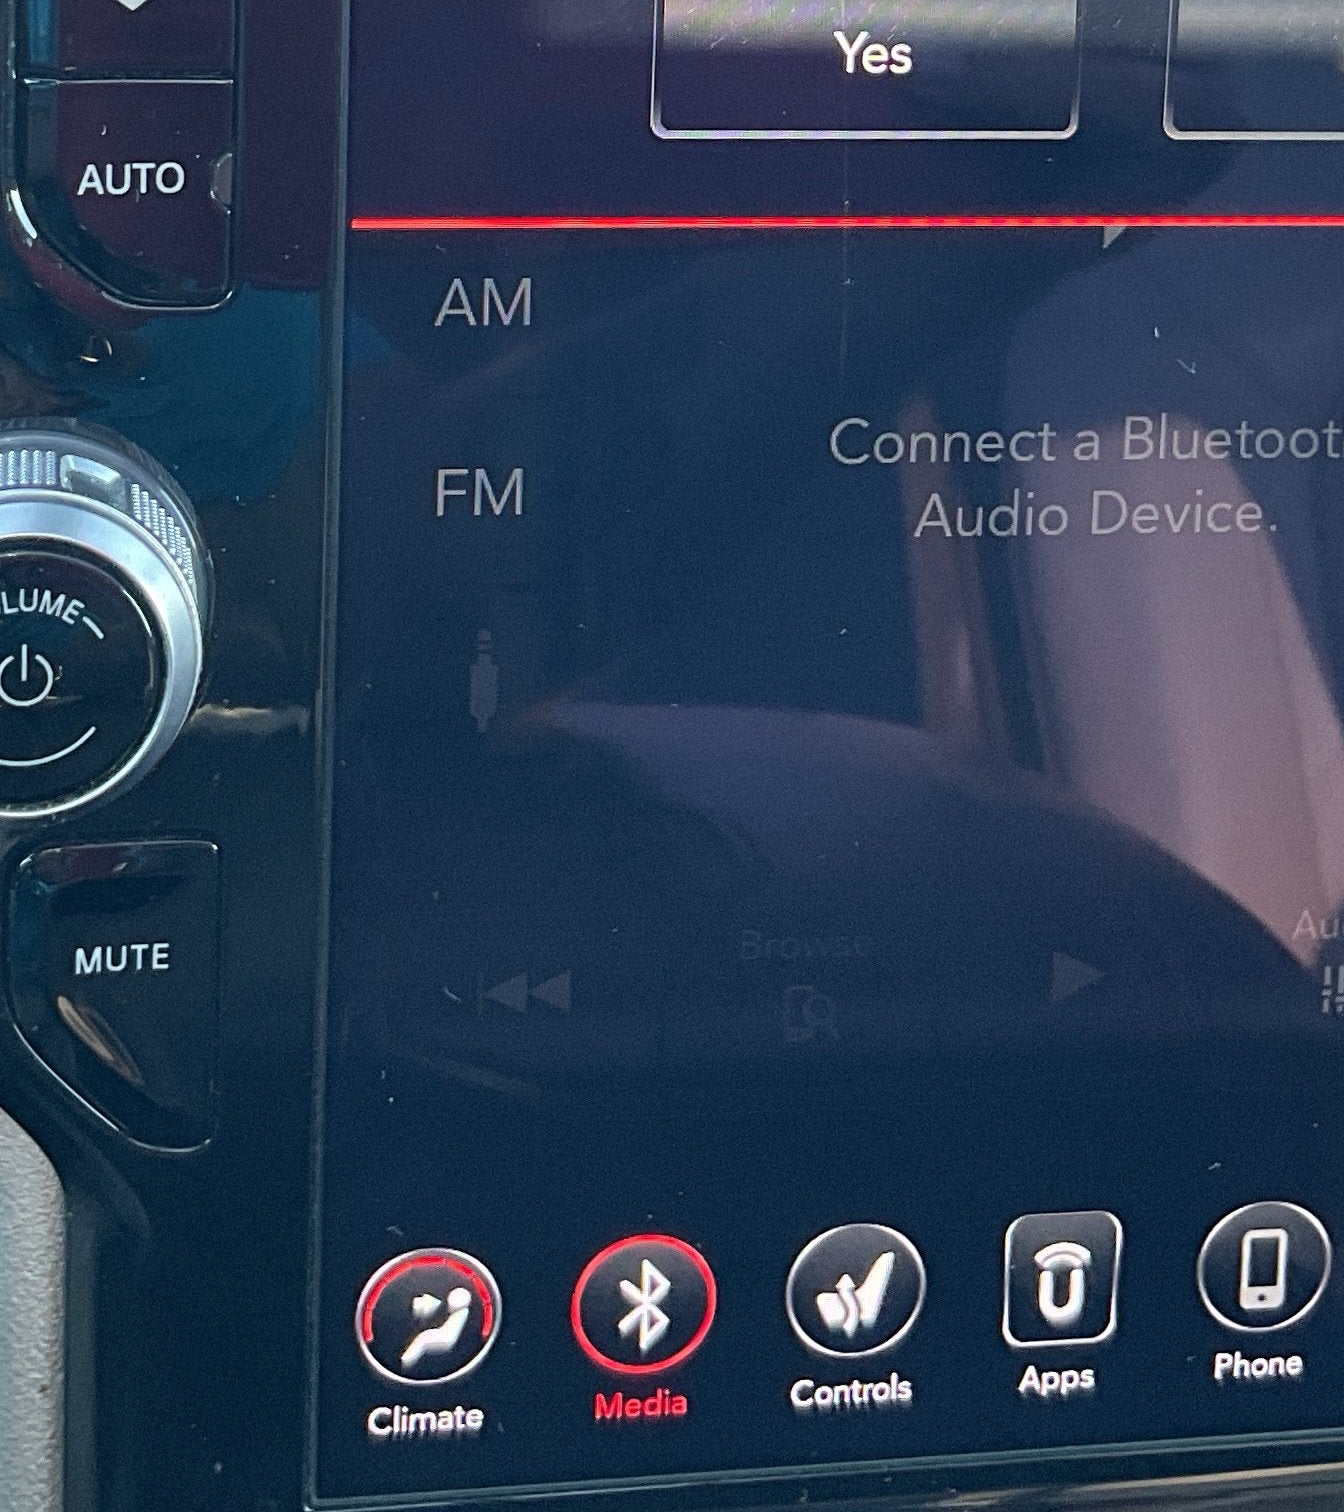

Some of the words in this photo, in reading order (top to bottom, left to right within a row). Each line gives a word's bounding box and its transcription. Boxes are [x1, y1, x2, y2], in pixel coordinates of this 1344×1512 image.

[834, 31, 912, 76] Yes
[77, 162, 184, 195] AUTO
[435, 278, 531, 326] AM
[829, 417, 1056, 466] Connect
[1074, 431, 1099, 461] a
[437, 468, 523, 516] FM
[914, 488, 1069, 537] Audio
[1090, 487, 1280, 536] Device.
[75, 943, 169, 974] MUTE
[1018, 1365, 1095, 1397] Apps
[1214, 1351, 1303, 1380] Phone
[595, 1388, 687, 1420] Media
[790, 1372, 912, 1409] Controls
[368, 1405, 484, 1436] Climate
